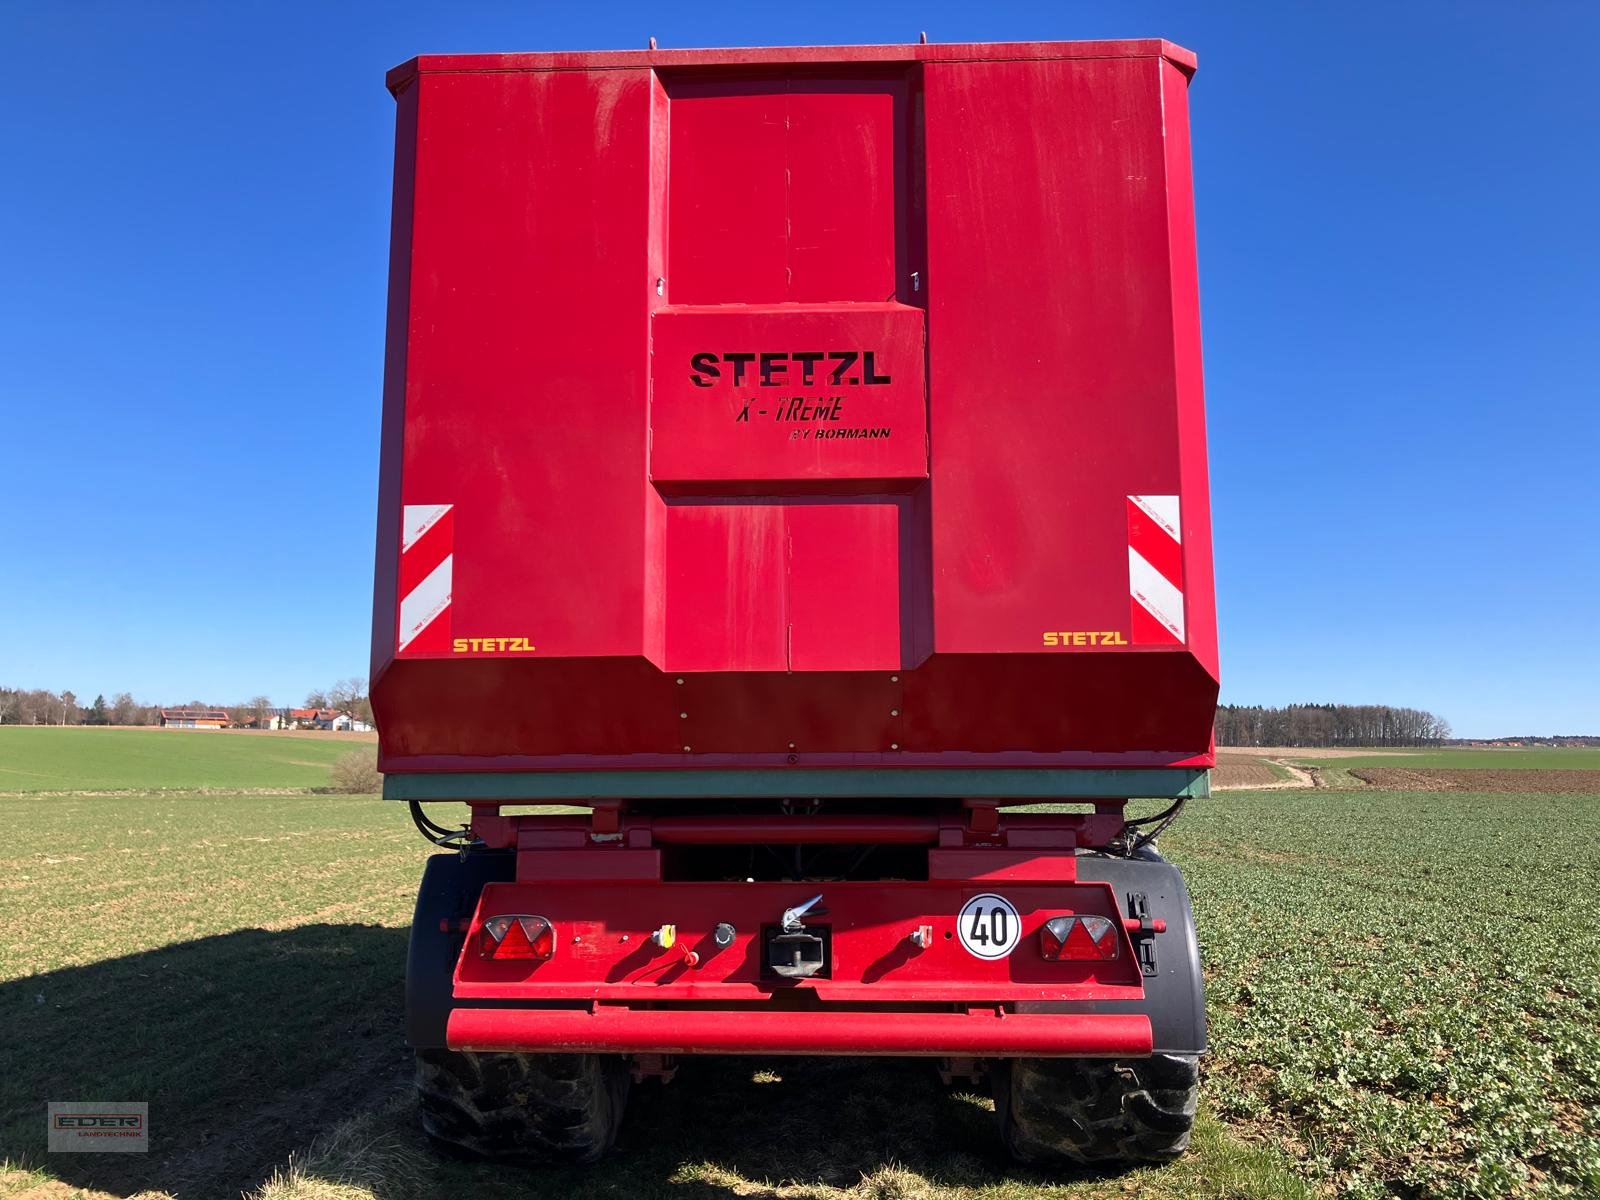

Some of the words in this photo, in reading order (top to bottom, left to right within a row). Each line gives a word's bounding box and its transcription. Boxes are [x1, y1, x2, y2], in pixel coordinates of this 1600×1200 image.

[690, 352, 892, 387] STETZL
[815, 428, 891, 440] BORMANN
[453, 637, 535, 652] STETZL
[1043, 631, 1128, 646] STETZL
[970, 907, 1008, 946] 40
